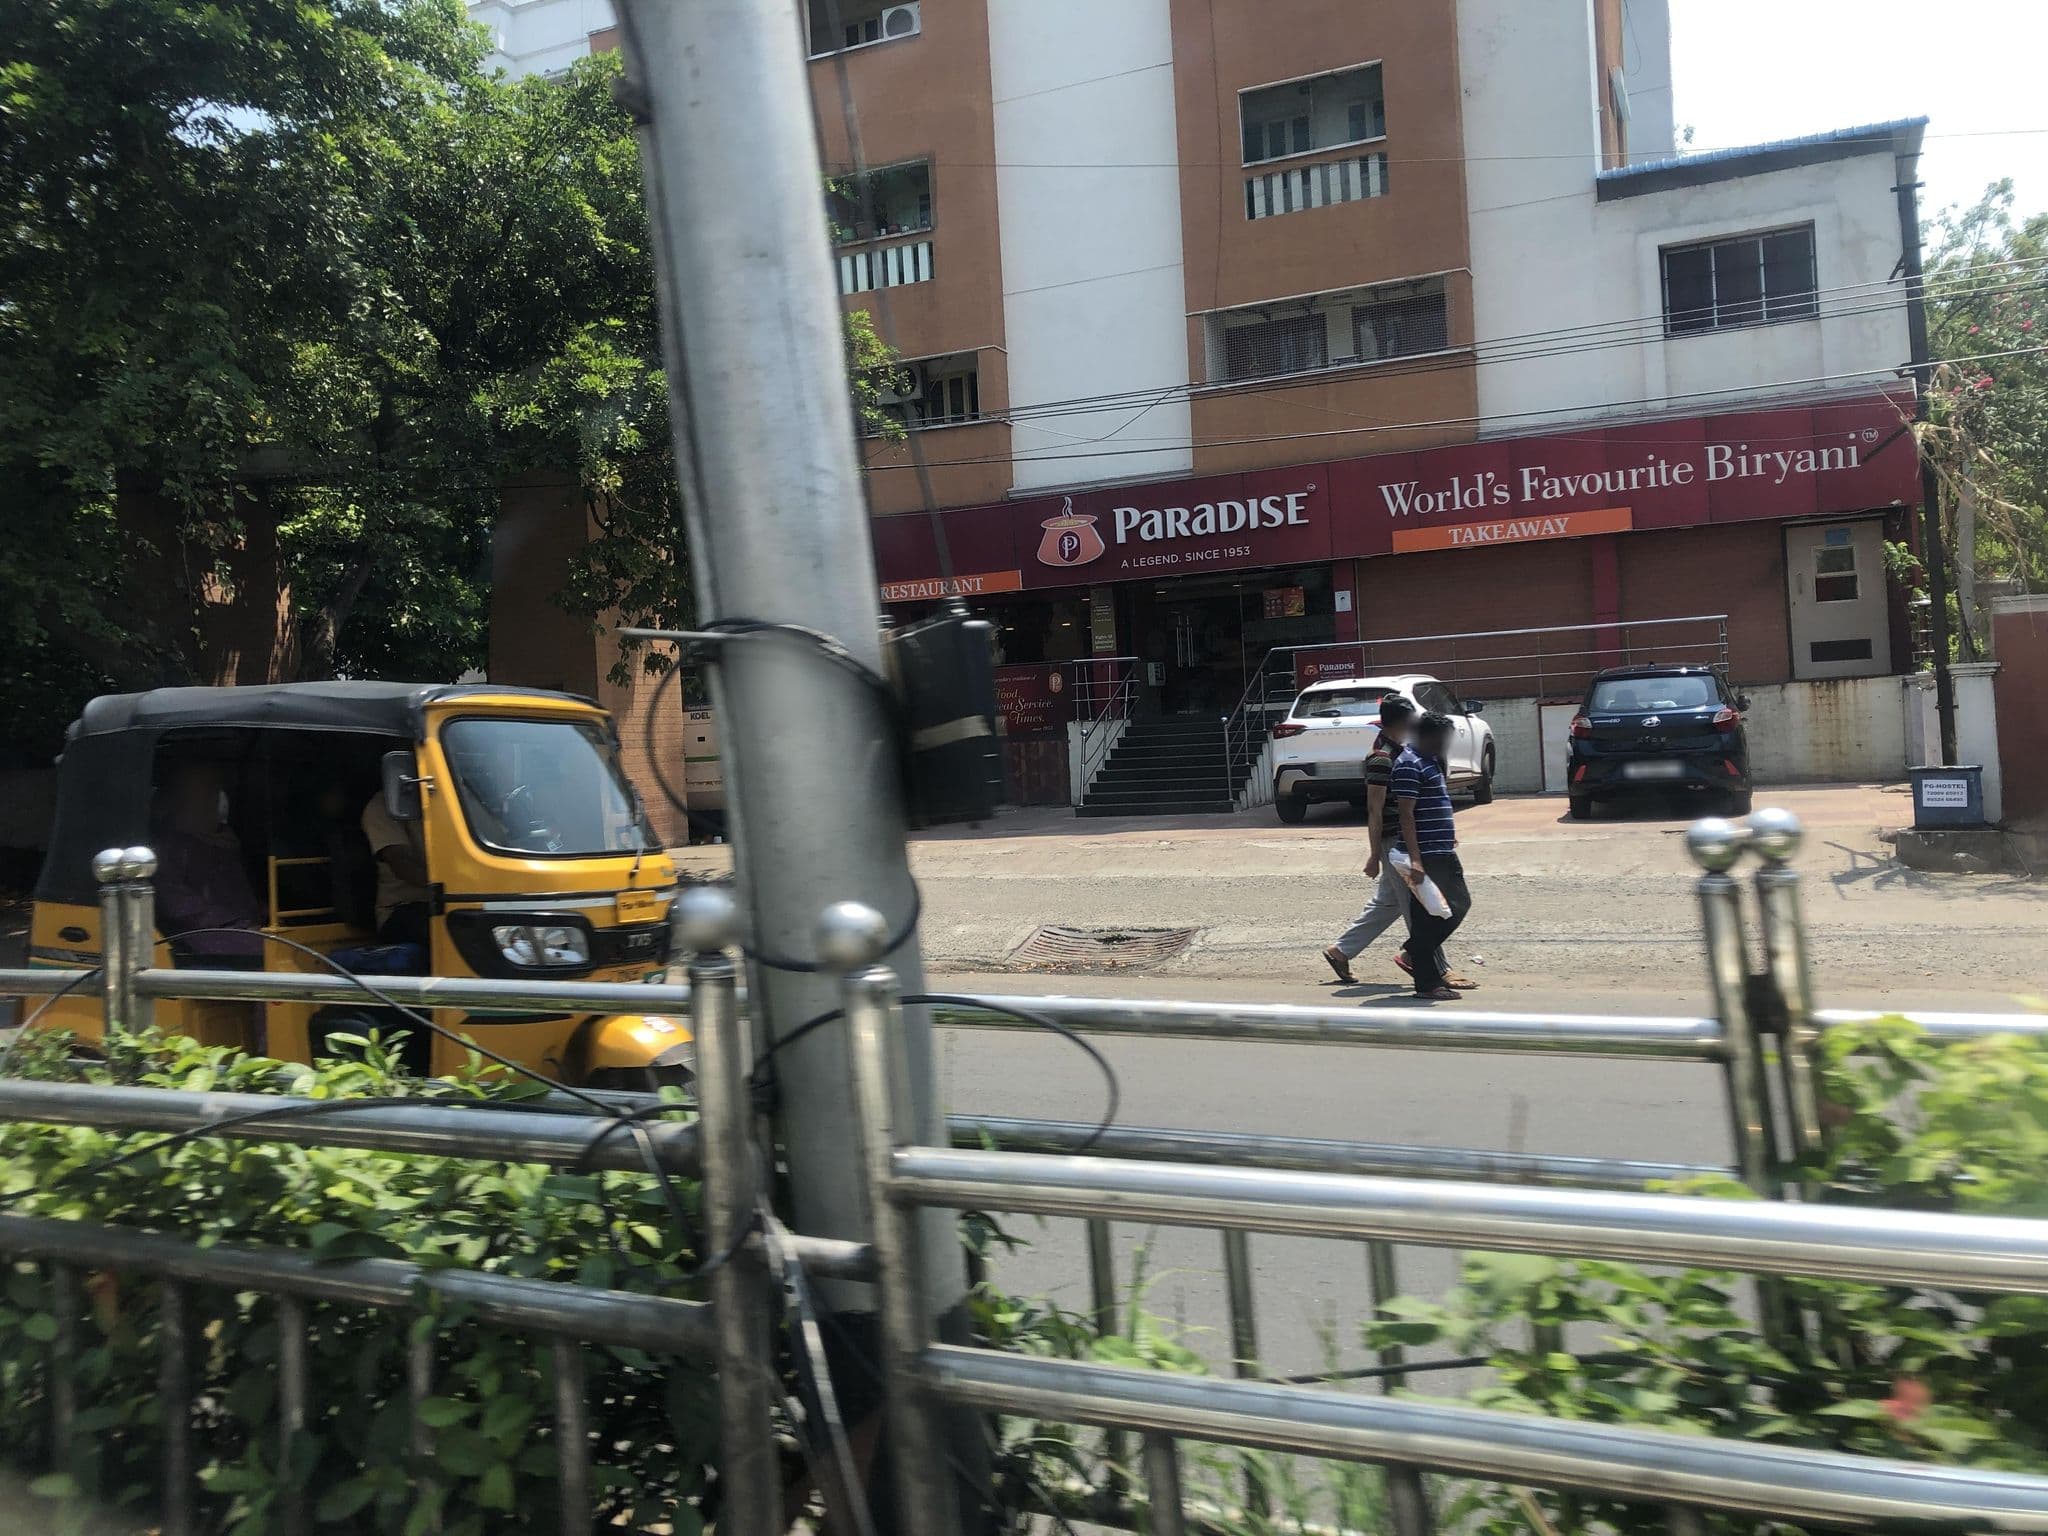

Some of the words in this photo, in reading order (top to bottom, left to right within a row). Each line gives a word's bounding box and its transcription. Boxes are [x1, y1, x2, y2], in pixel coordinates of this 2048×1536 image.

[1377, 471, 1510, 518] World's
[1519, 454, 1694, 502] Favourite
[1704, 432, 1862, 484] Biryani
[1448, 517, 1571, 545] TAKEAWAY
[1120, 559, 1129, 569] A
[1133, 553, 1182, 568] LEGEND.
[1185, 548, 1220, 562] SINCE
[1223, 545, 1251, 558] 1953
[881, 577, 984, 600] RESTAURANT
[690, 712, 711, 720] KOEL
